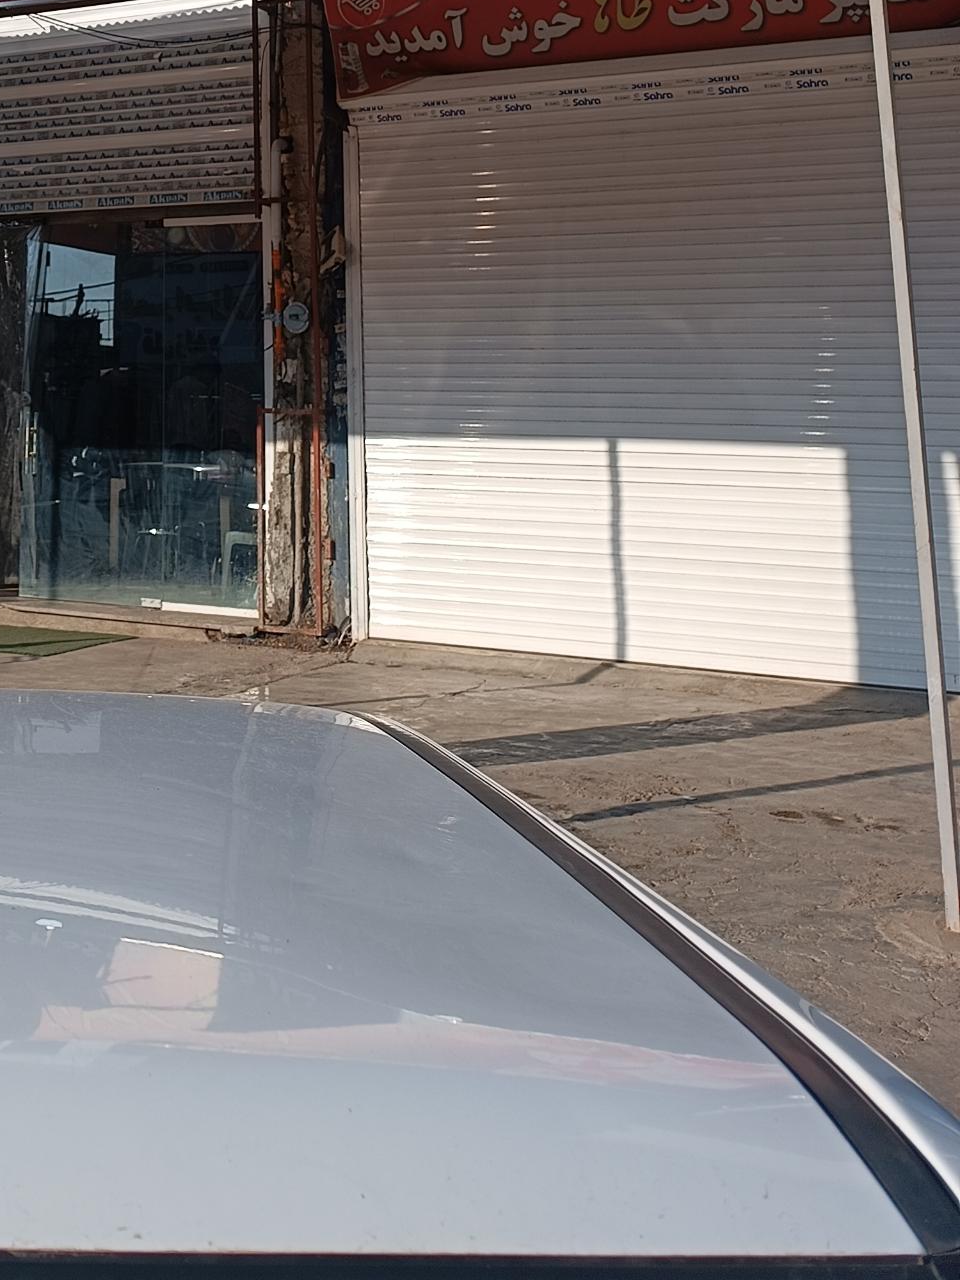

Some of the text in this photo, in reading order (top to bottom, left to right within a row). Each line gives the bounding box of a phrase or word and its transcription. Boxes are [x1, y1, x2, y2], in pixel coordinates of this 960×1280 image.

[366, 7, 468, 62] آمدید
[481, 0, 582, 57] خوش
[376, 113, 402, 122] Sahra
[439, 108, 466, 118] Sahra
[504, 102, 532, 112] Sahra
[572, 97, 601, 107] Sahra
[643, 91, 674, 101] Sahra
[717, 84, 750, 95] Sahra
[796, 79, 829, 89] Sahra
